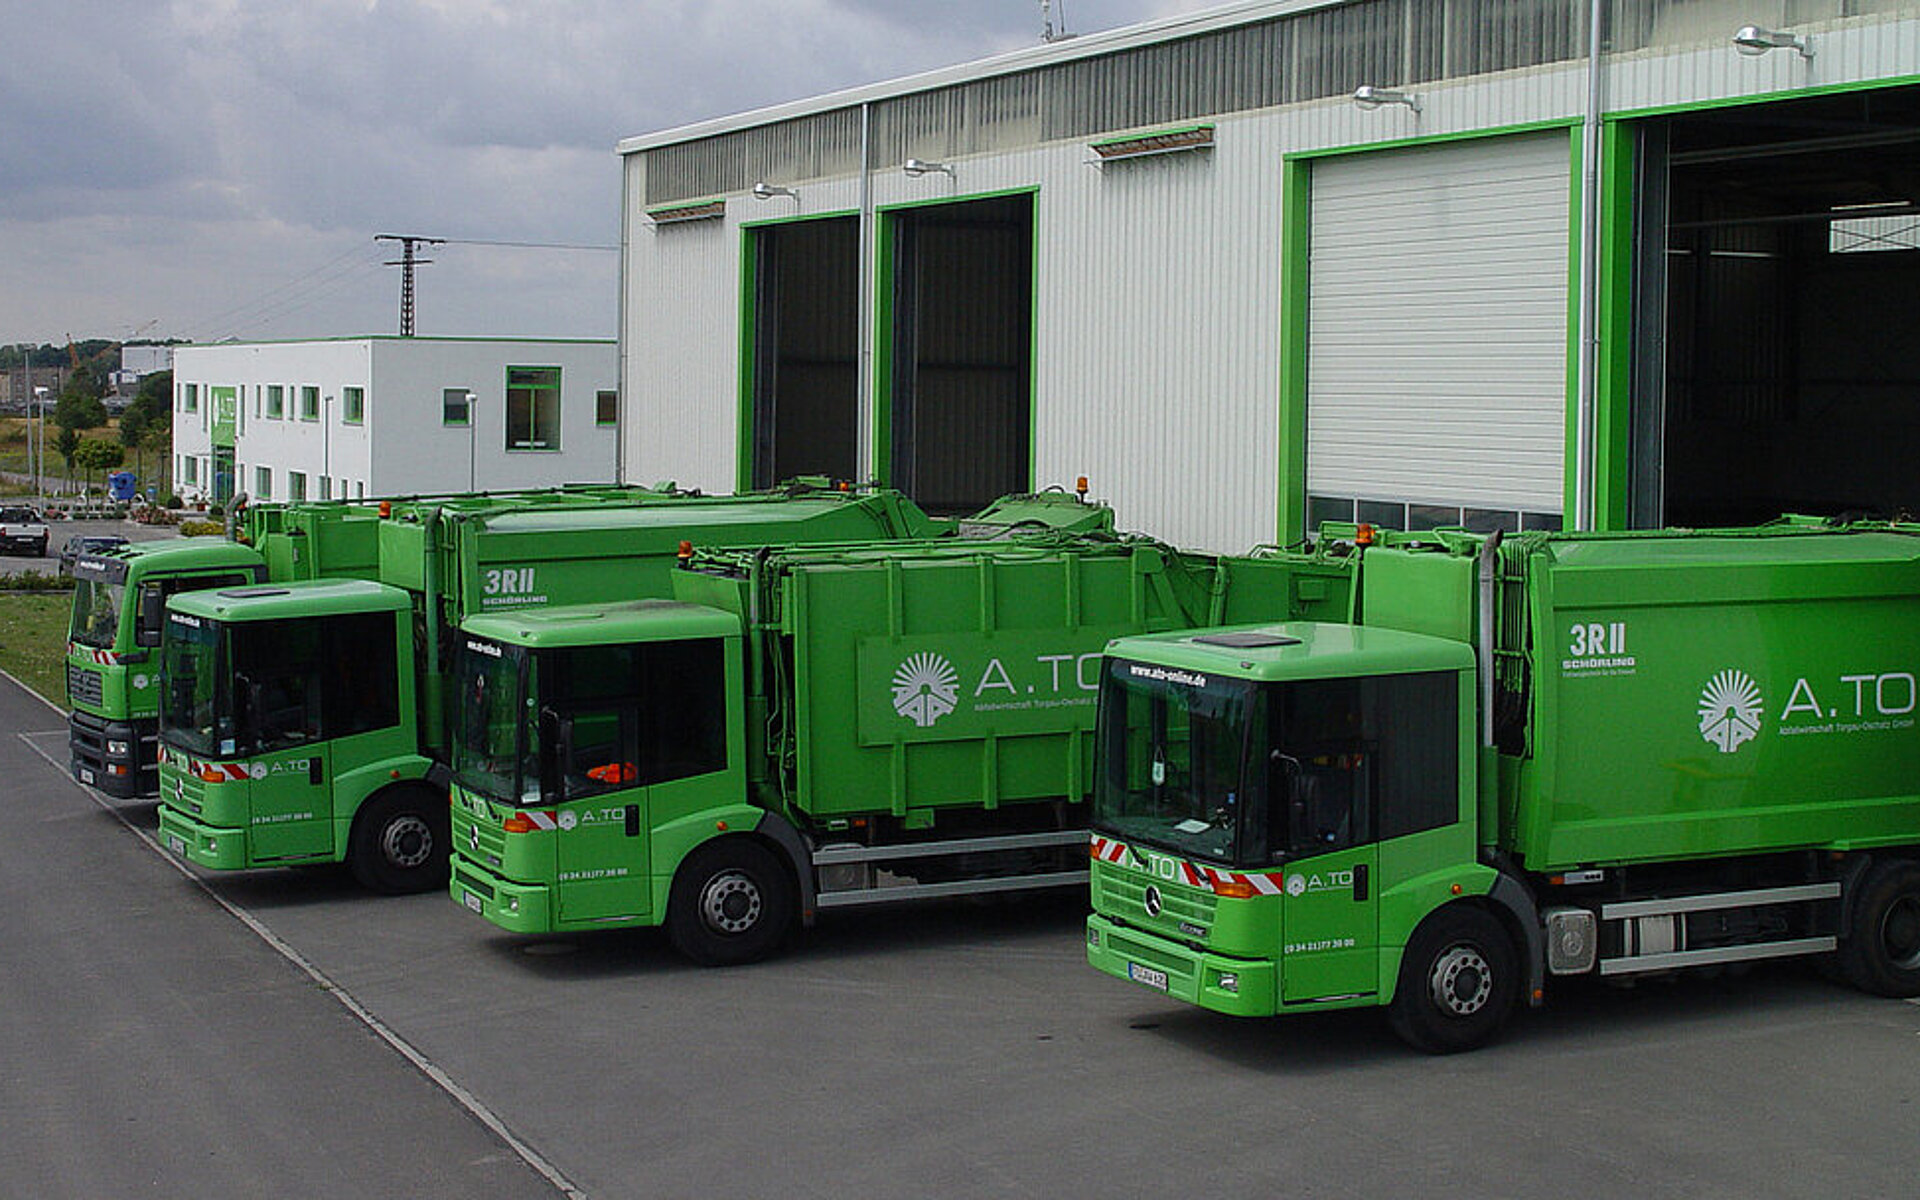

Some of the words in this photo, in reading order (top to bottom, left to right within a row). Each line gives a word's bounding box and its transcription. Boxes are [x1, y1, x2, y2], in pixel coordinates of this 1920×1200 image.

[1780, 672, 1916, 720] A.TO
[581, 807, 626, 822] A.TO
[1307, 871, 1354, 886] A.TO
